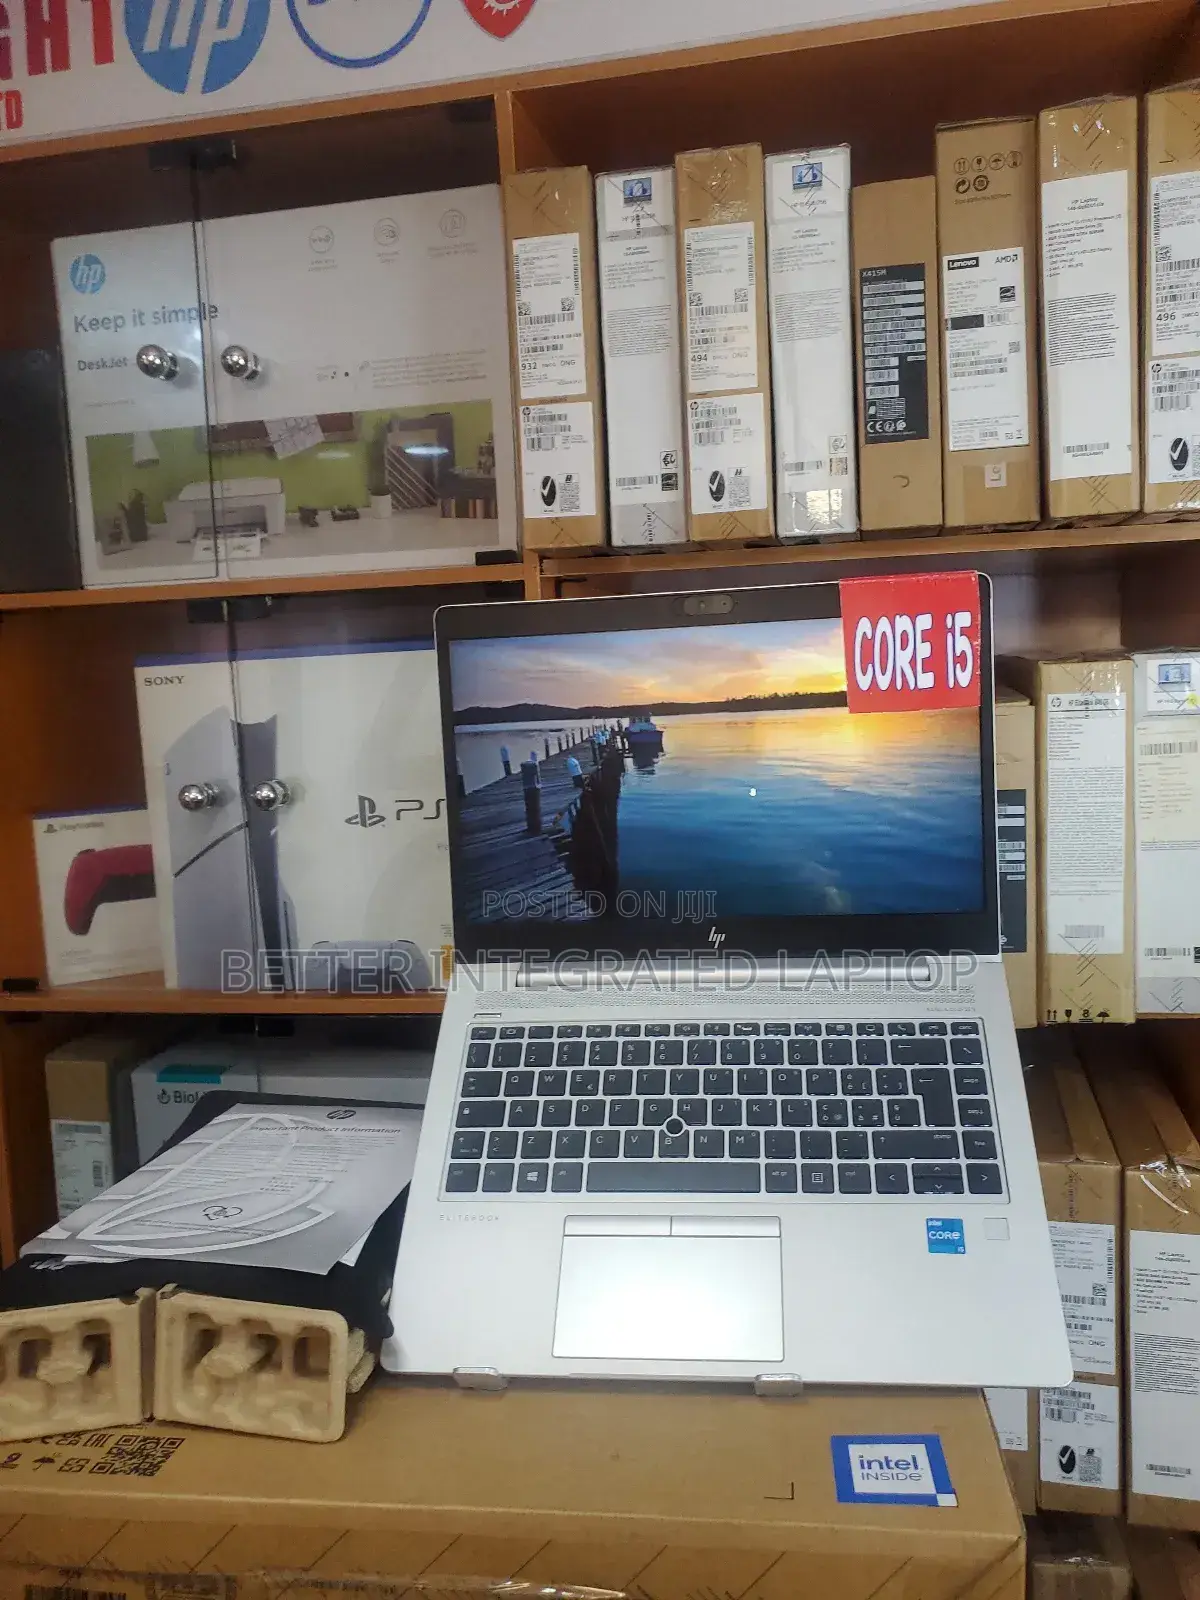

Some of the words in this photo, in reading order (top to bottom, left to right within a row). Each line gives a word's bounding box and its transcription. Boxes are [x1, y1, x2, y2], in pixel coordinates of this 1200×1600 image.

[0, 0, 115, 80] HT
[949, 259, 977, 268] Lenovo
[994, 255, 1012, 264] AMD
[74, 313, 126, 333] Keep
[132, 307, 146, 327] it
[153, 302, 219, 325] simple
[1156, 312, 1176, 322] 496
[77, 356, 128, 371] DeskJet
[690, 353, 708, 362] 494
[521, 361, 537, 371] 932
[855, 613, 935, 692] CORE
[945, 611, 973, 689] i5
[144, 676, 184, 687] SONY
[708, 926, 726, 949] hp
[301, 1125, 341, 1133] Product
[341, 1126, 401, 1134] Information
[858, 1454, 919, 1471] intel
